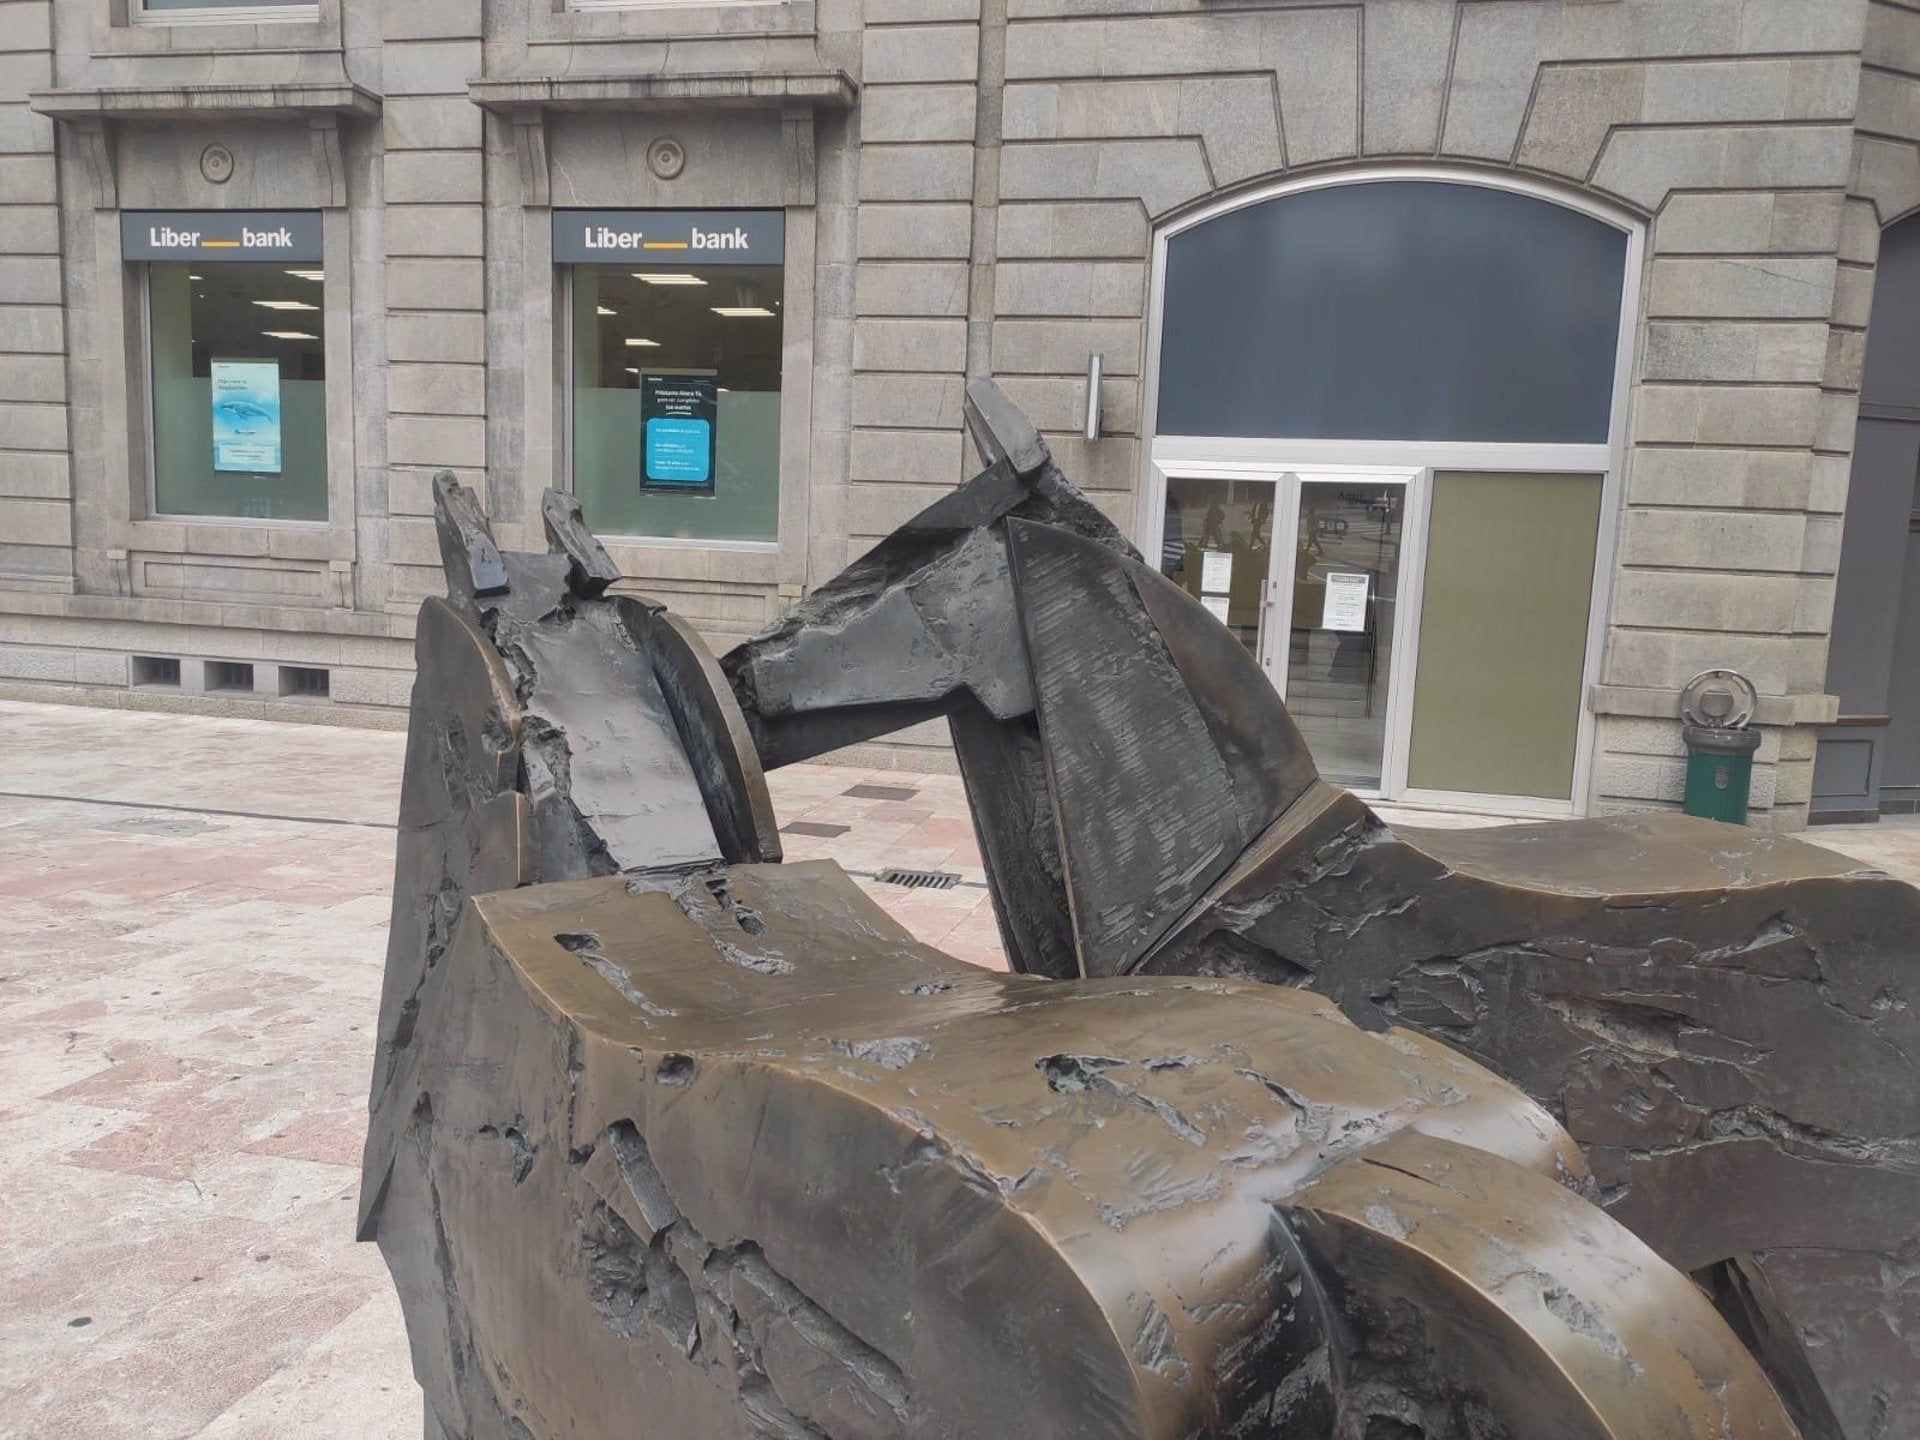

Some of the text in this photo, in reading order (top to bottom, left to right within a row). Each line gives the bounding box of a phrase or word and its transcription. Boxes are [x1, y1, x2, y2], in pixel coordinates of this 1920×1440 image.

[150, 227, 293, 247] Liber bank
[585, 227, 749, 249] Liber bank
